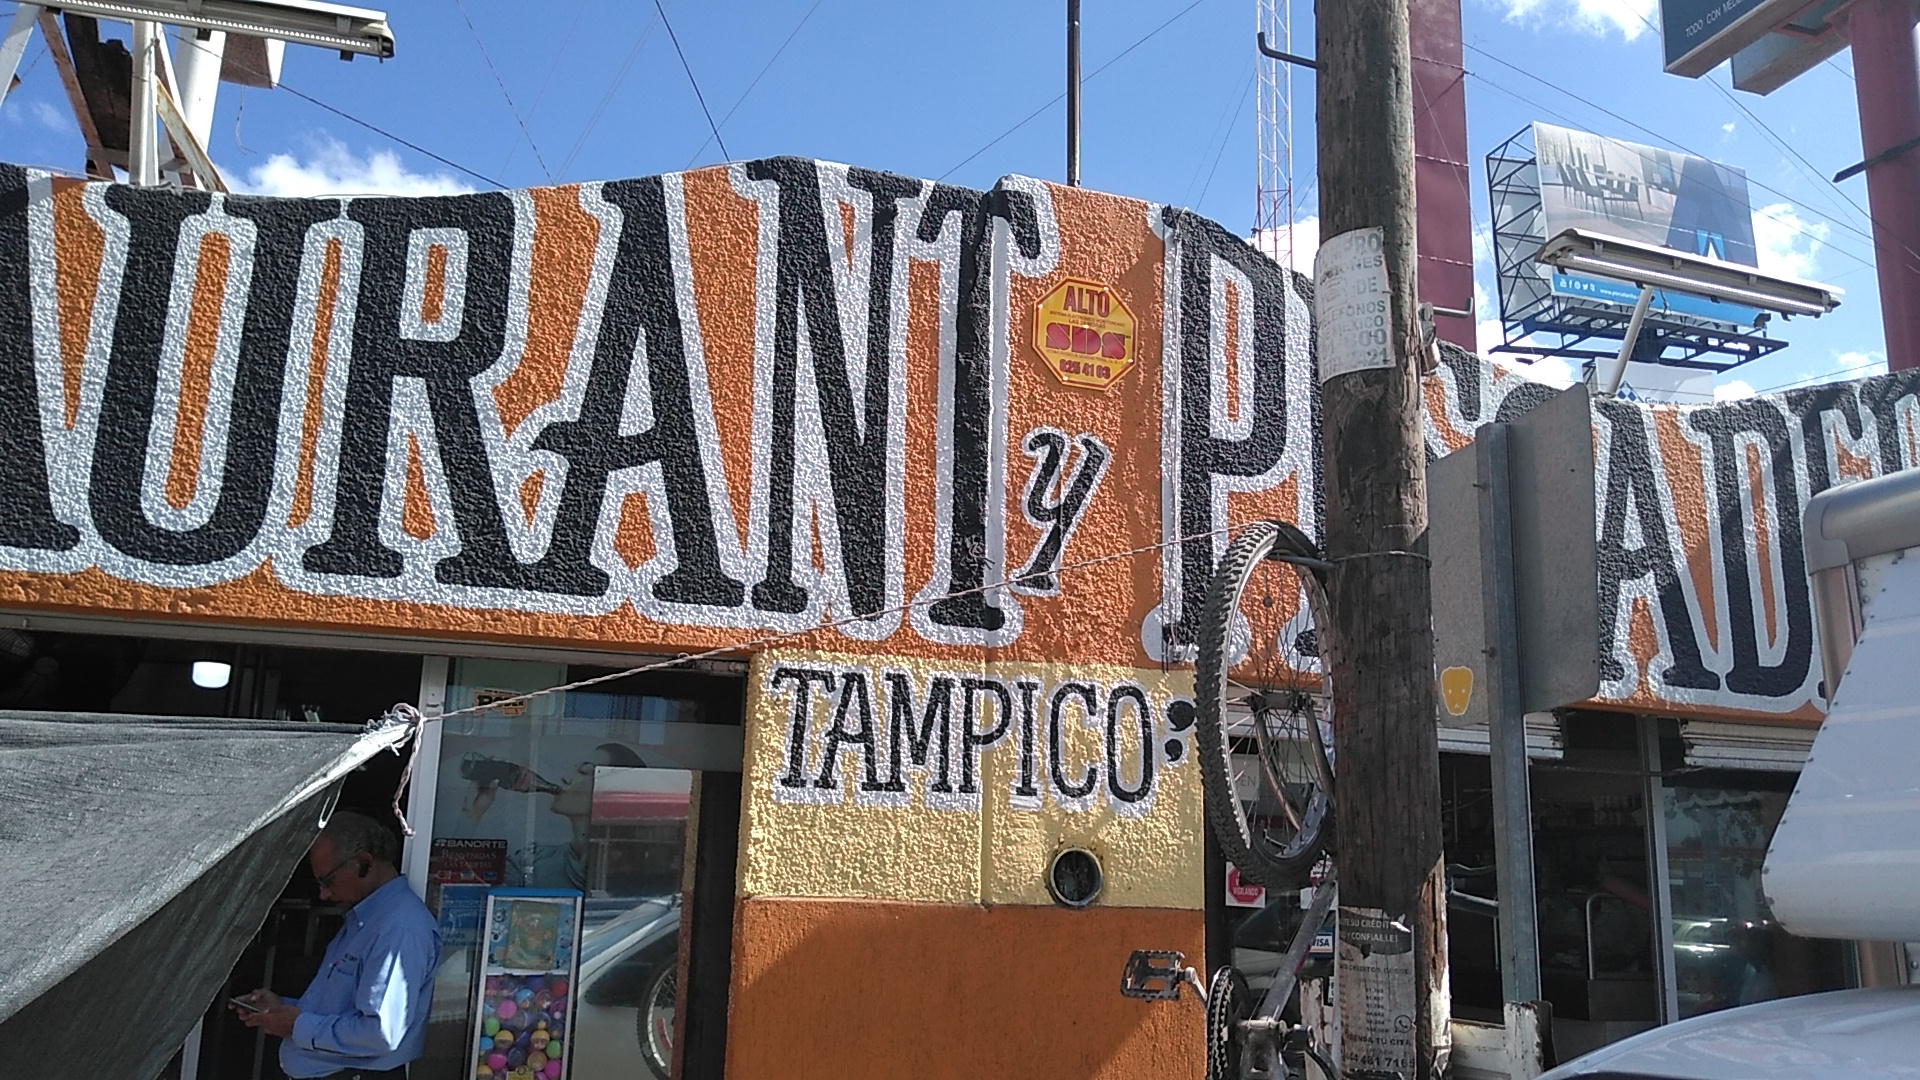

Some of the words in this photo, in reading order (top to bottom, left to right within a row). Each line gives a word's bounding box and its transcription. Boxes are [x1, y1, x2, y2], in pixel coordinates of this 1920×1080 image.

[1685, 19, 1704, 38] TODO
[1706, 7, 1721, 25] CON
[1356, 276, 1379, 296] DE
[1063, 285, 1110, 318] ALTO
[1045, 321, 1126, 361] SDS
[1021, 430, 1109, 591] y
[771, 666, 1155, 803] TAMPICO
[447, 840, 506, 849] BANORTE
[1351, 919, 1360, 927] SU
[1311, 938, 1330, 947] VISA
[1375, 1037, 1387, 1045] TU
[1389, 1038, 1412, 1046] CITA
